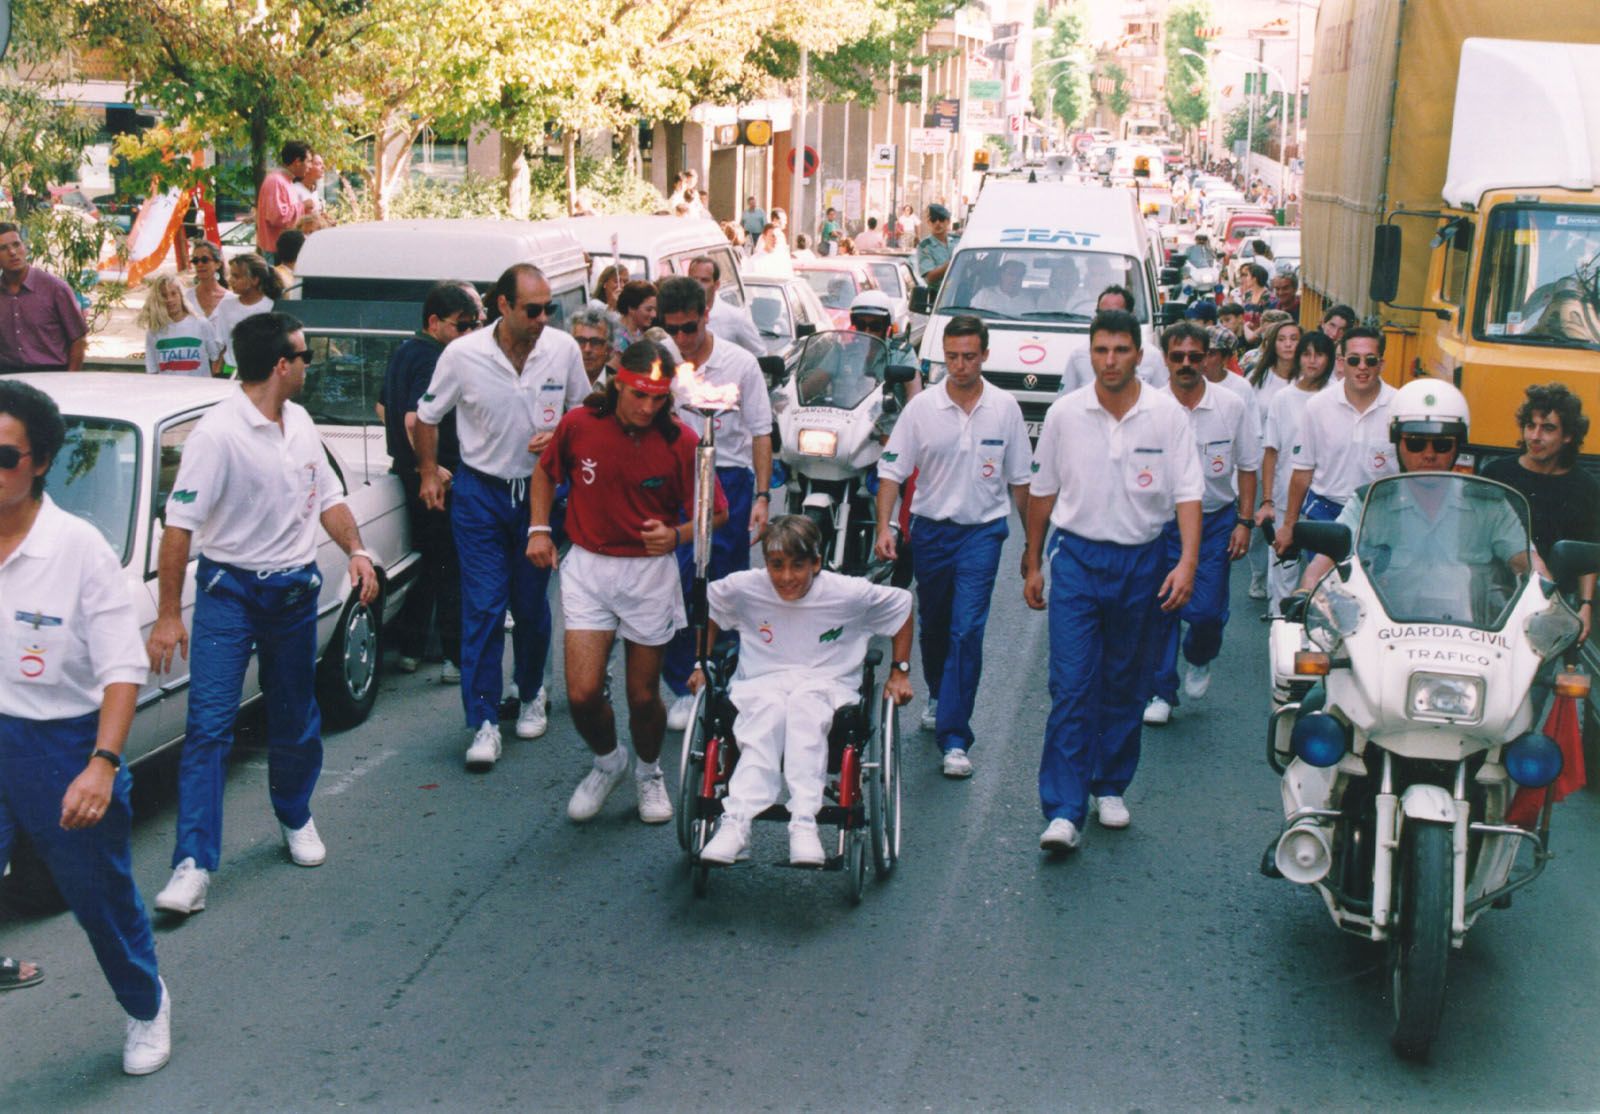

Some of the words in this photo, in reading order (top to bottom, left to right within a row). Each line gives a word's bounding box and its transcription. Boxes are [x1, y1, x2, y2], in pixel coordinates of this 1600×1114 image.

[1000, 228, 1101, 246] SEAT
[1378, 626, 1463, 640] GUARDIA
[1468, 630, 1512, 650] CIVIL
[1406, 649, 1491, 666] TRAFICO
